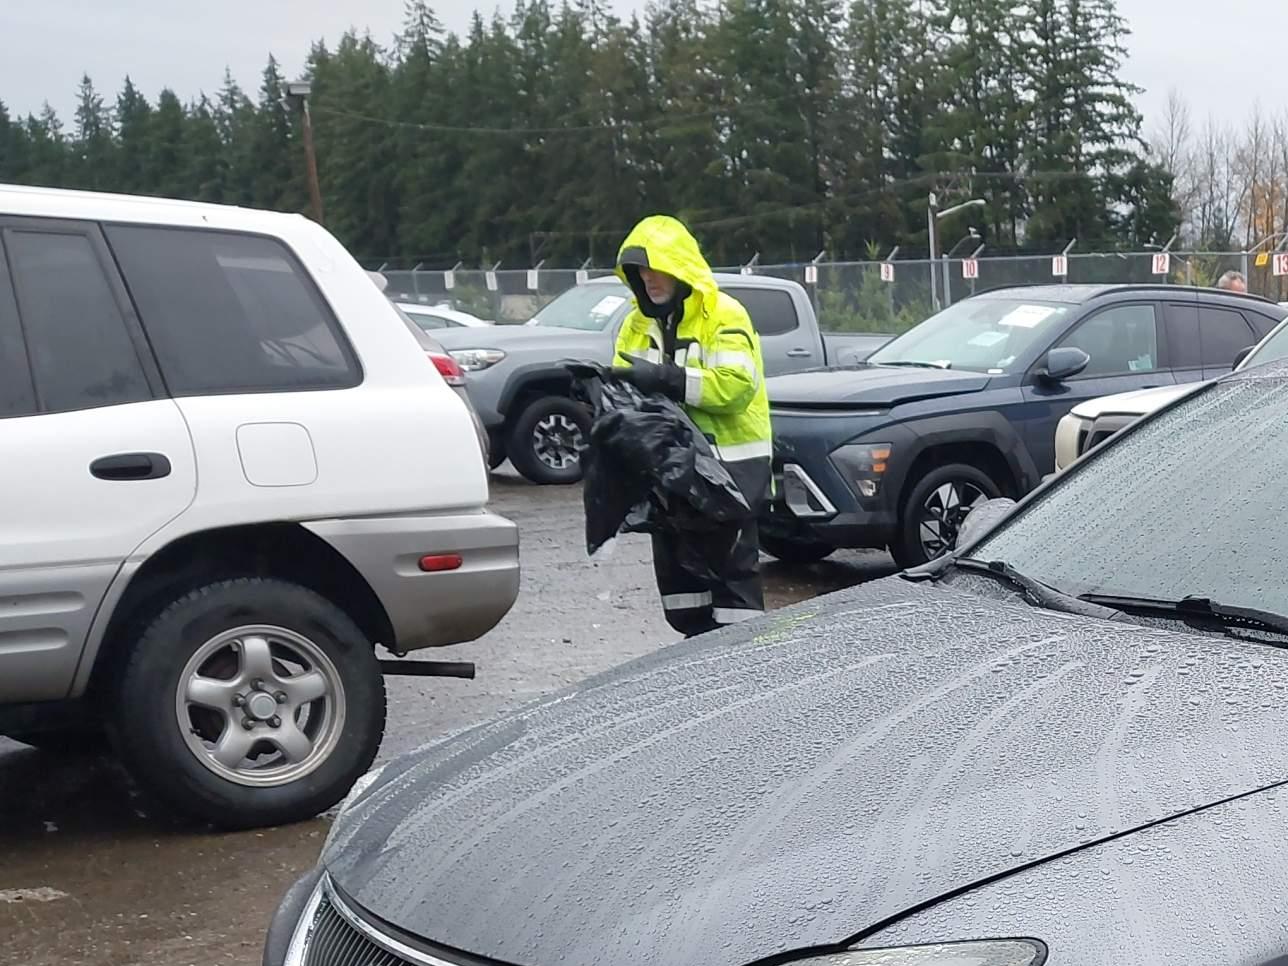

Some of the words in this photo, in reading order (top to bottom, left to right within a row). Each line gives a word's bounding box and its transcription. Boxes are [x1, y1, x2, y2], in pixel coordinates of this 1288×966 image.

[966, 260, 976, 277] 10
[1056, 257, 1064, 274] 11
[1156, 254, 1166, 272] 12
